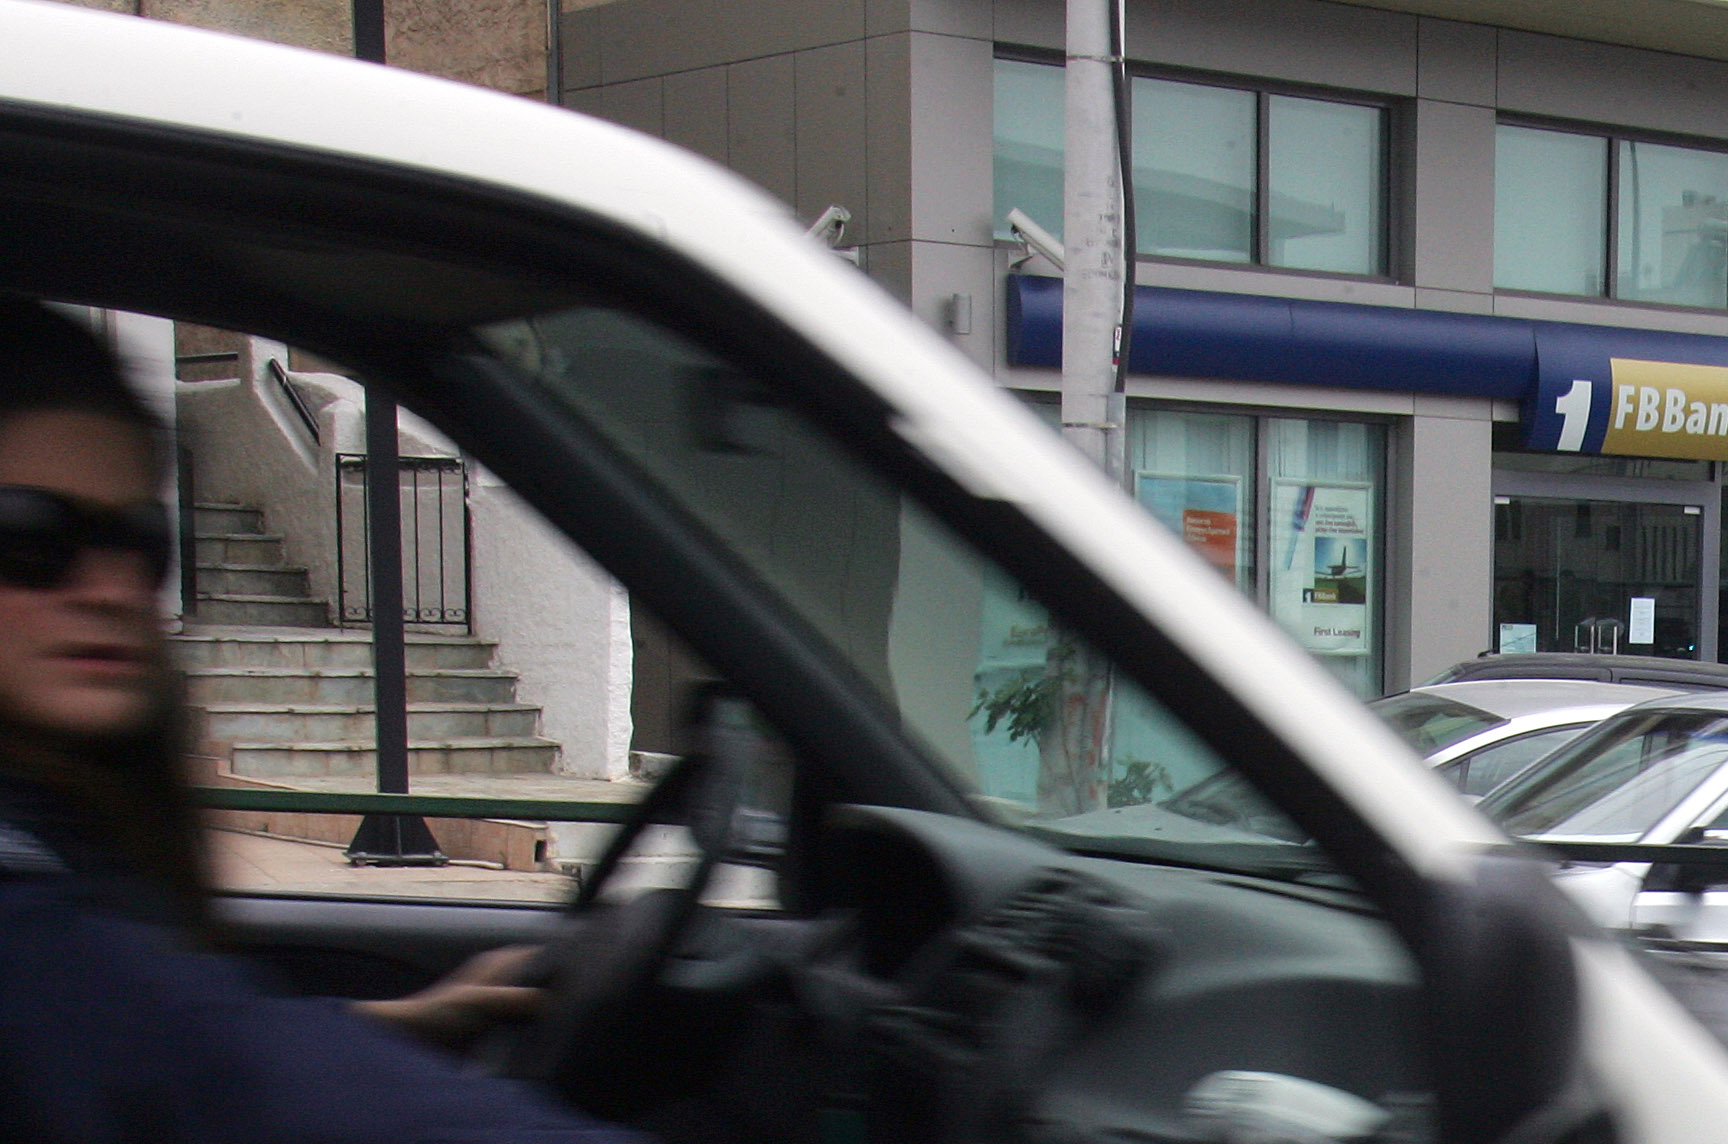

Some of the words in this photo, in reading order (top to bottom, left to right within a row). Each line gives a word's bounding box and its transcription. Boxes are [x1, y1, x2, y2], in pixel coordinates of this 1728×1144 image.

[1555, 379, 1593, 452] 1
[1313, 626, 1331, 636] First
[1332, 627, 1361, 639] Leasing
